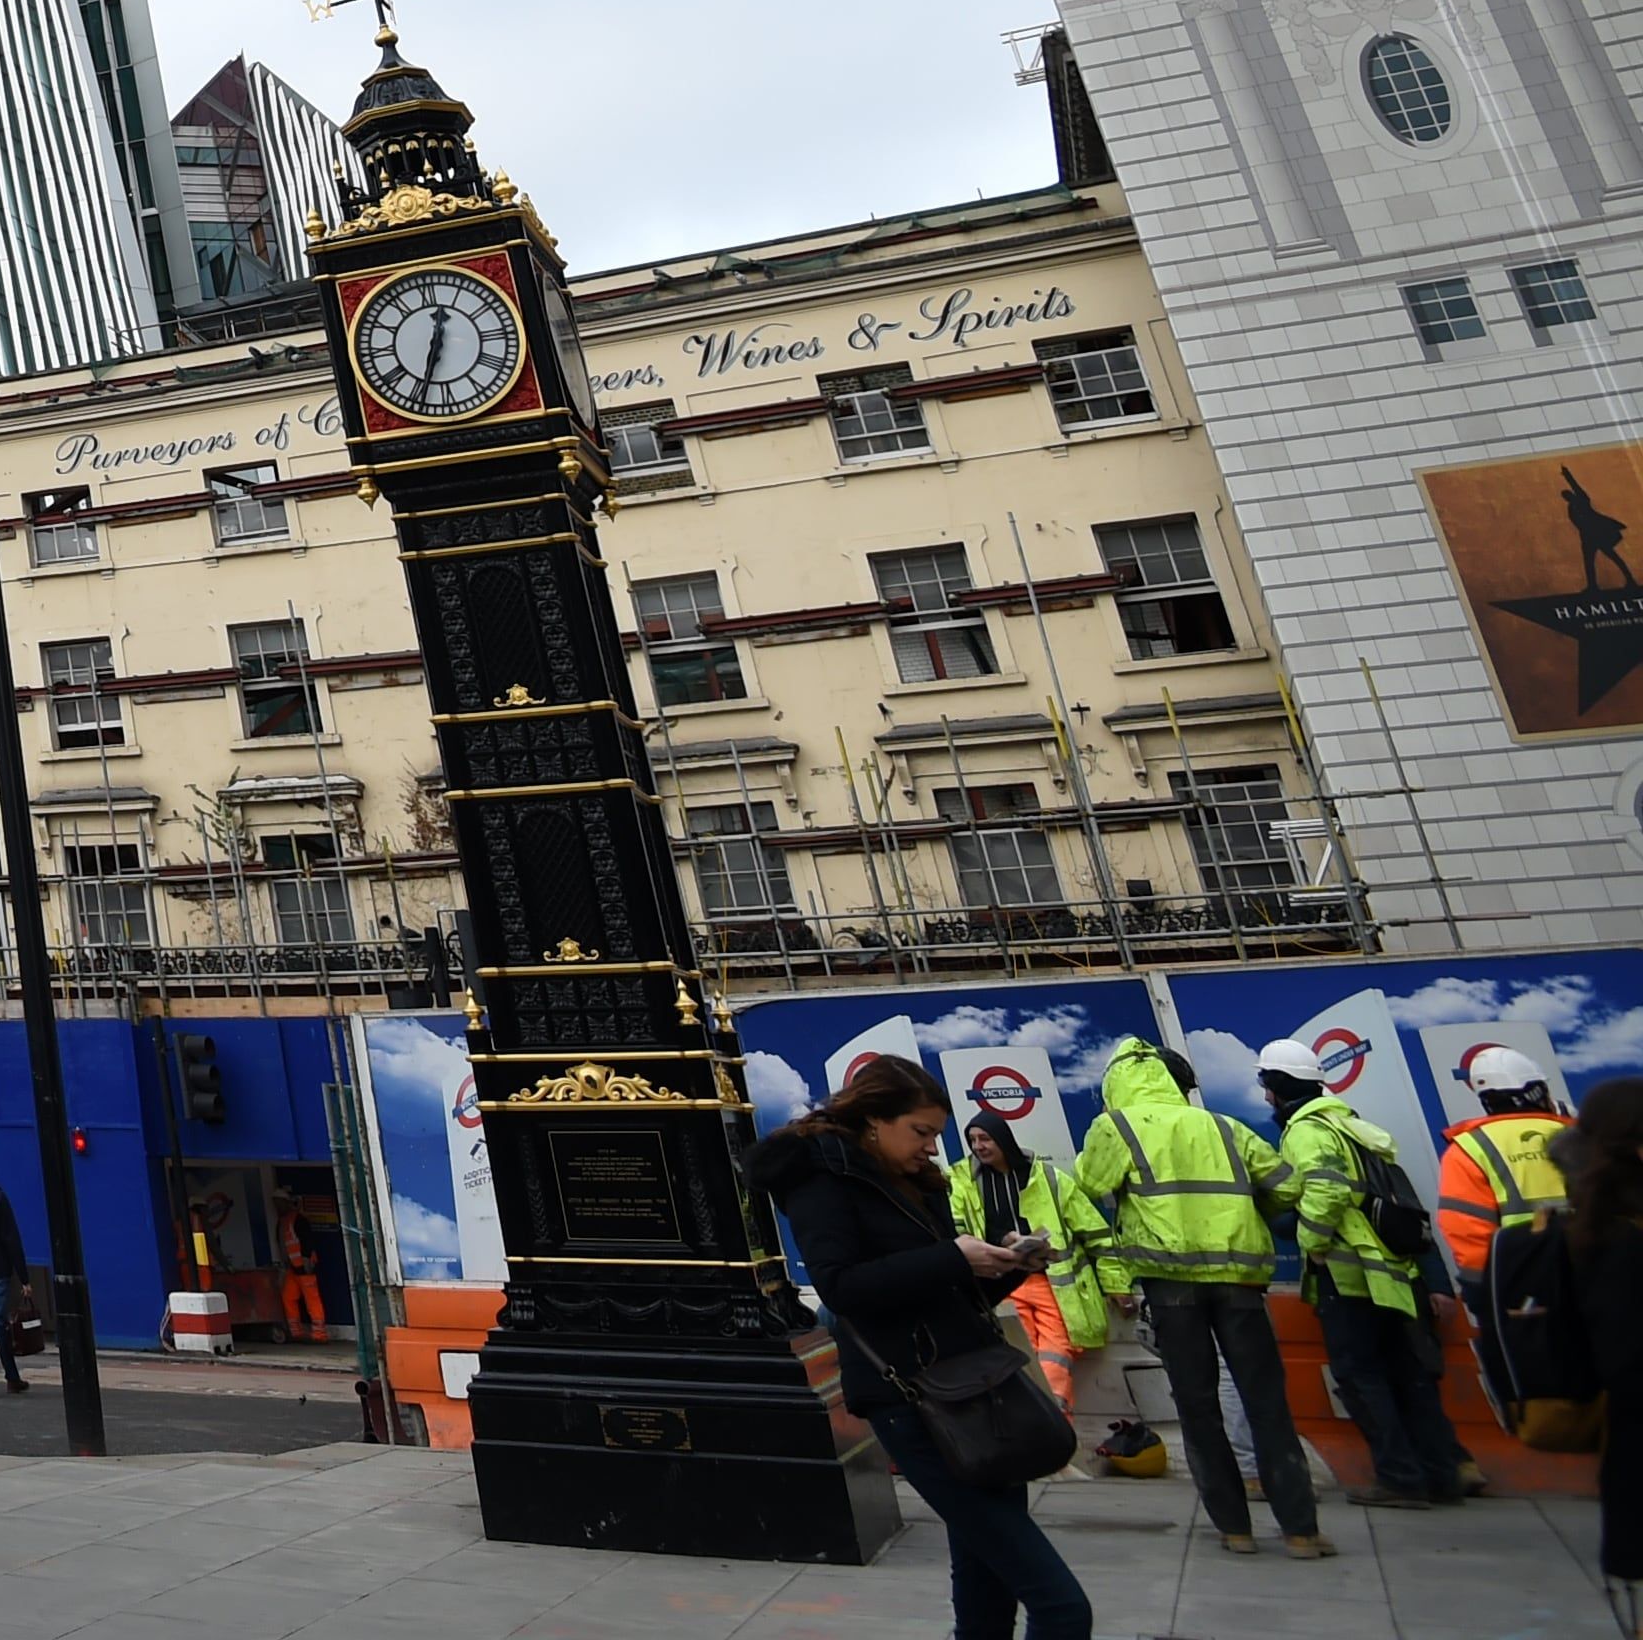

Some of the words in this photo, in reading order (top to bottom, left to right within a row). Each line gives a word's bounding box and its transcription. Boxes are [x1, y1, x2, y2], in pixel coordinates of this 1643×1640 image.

[56, 432, 237, 475] Purveyors
[255, 413, 290, 451] of
[683, 322, 825, 378] Wines
[847, 313, 903, 352] &
[908, 287, 1076, 346] Spirits
[1555, 597, 1643, 620] HAMILT
[981, 1089, 1026, 1099] VICTORIA
[464, 1176, 487, 1190] TICKET
